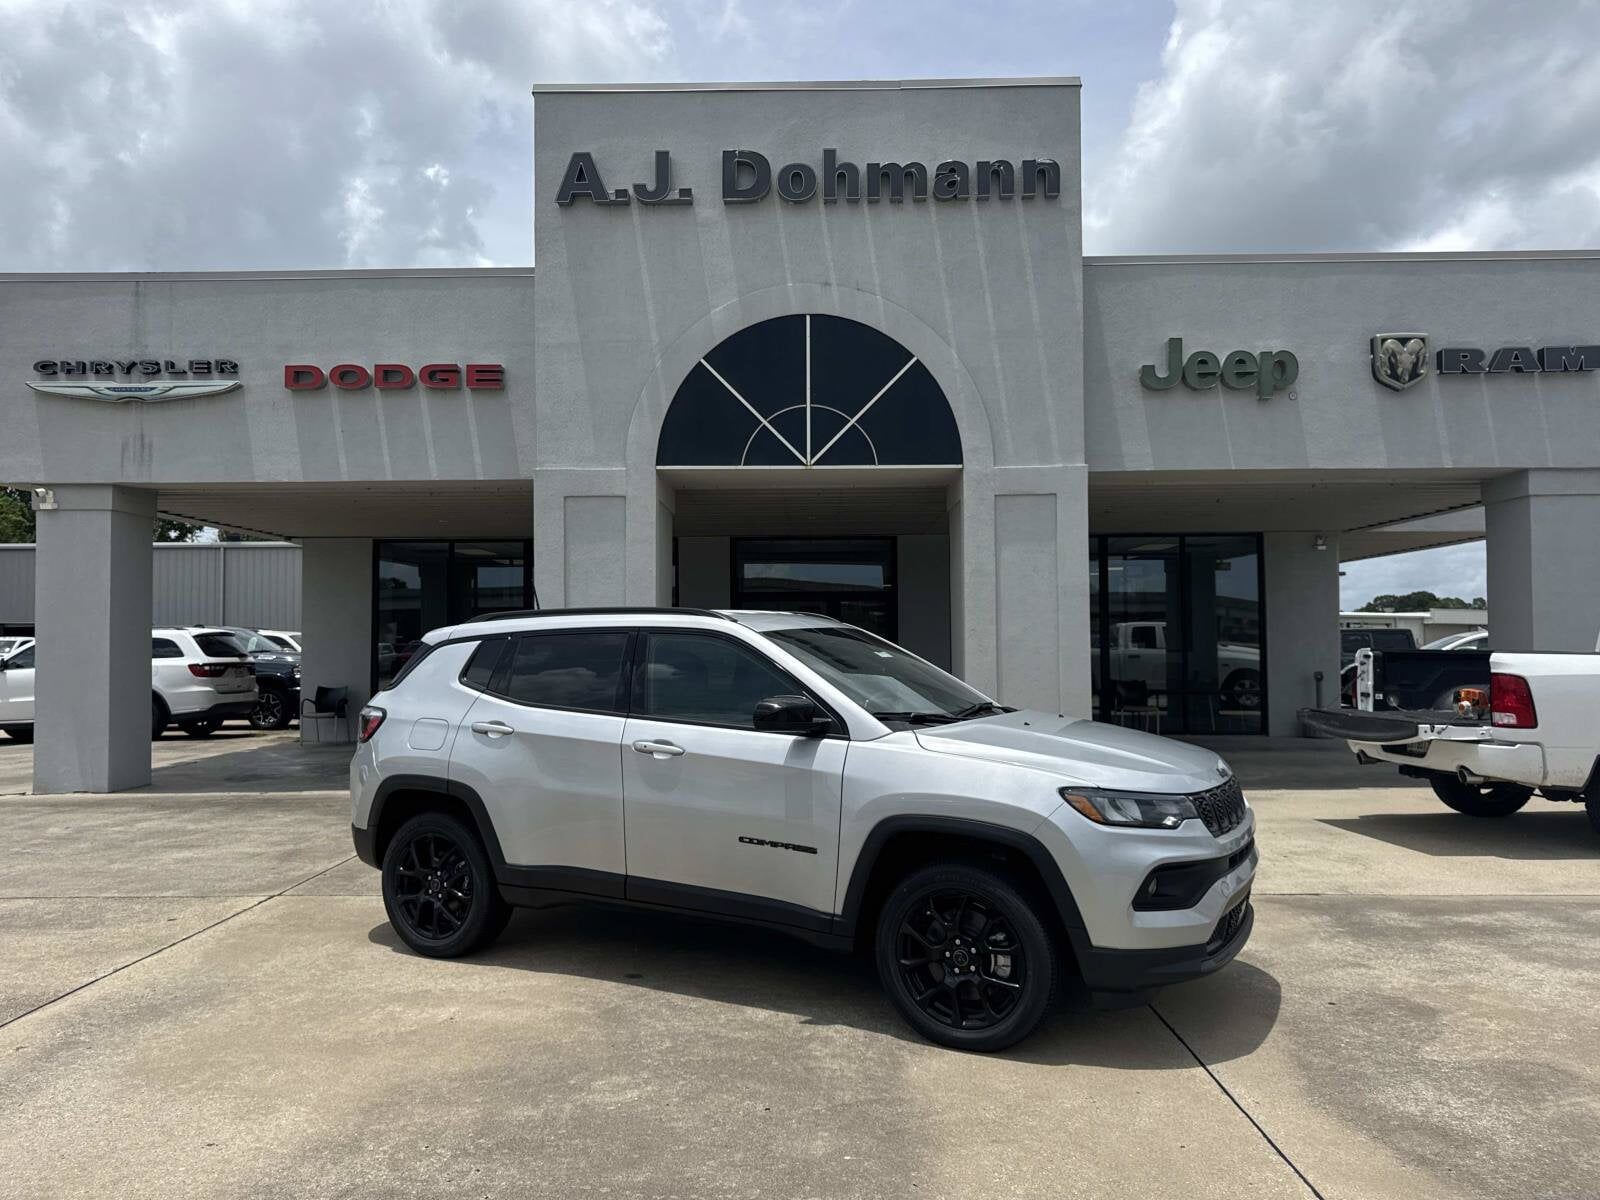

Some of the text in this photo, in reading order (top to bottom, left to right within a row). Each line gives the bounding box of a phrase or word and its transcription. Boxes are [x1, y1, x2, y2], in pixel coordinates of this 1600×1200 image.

[556, 148, 1062, 206] A.J. Dohmann
[32, 358, 240, 376] CHRYSLER
[1139, 337, 1299, 401] Jeep
[1436, 344, 1600, 375] RAM
[284, 364, 505, 390] DODGE
